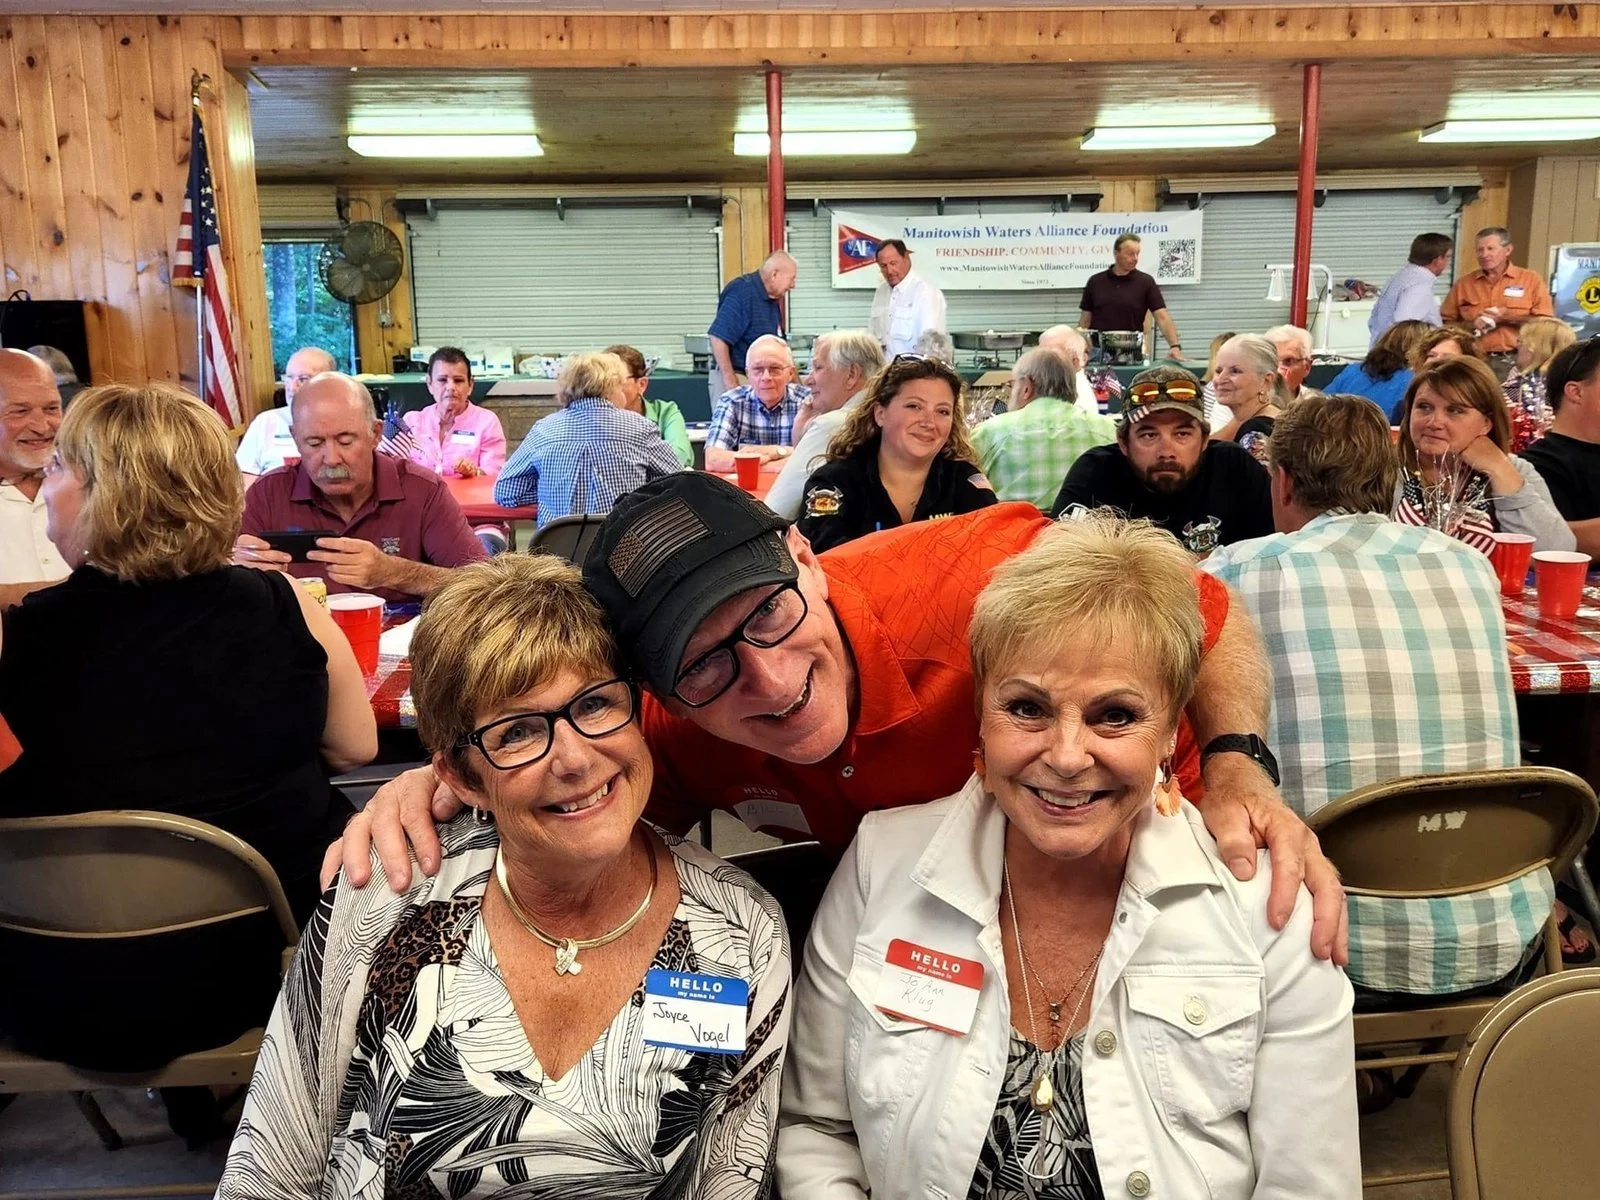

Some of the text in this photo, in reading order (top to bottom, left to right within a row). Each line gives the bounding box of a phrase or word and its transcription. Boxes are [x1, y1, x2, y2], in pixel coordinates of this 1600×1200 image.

[903, 222, 1169, 239] Manitowish Waters Alliance Foundation
[1091, 245, 1110, 254] GIV
[744, 787, 778, 796] HELLO
[910, 950, 961, 973] HELLO
[669, 977, 723, 993] HELLO
[688, 991, 707, 999] name
[652, 1001, 690, 1023] Joyce
[689, 1023, 730, 1049] Vogel
